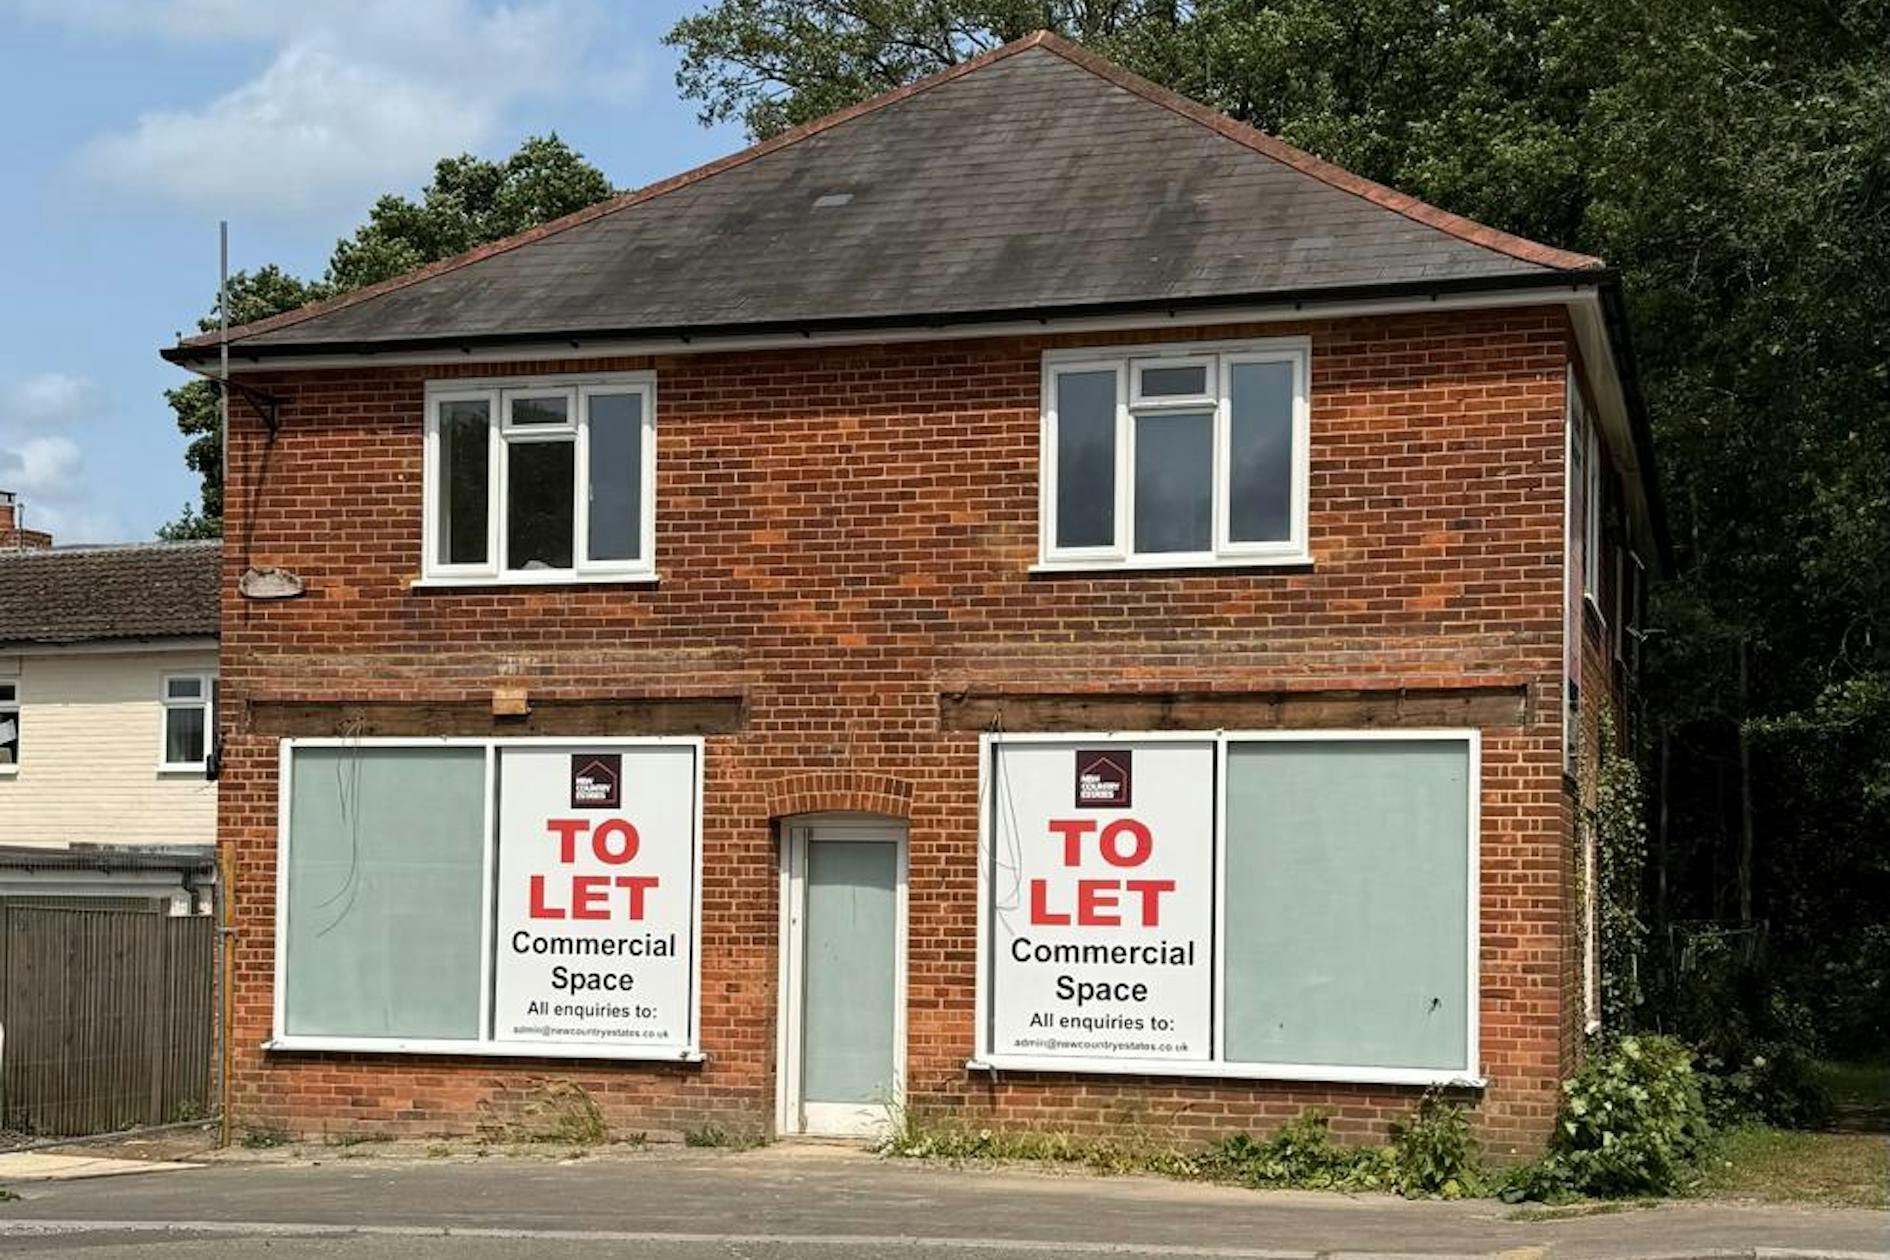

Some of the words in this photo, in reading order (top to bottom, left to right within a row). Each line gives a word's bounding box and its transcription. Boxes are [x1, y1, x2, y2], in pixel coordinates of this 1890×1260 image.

[548, 819, 639, 864] TO
[1049, 818, 1152, 868] TO
[529, 875, 659, 919] LET
[1030, 879, 1175, 926] LET
[512, 931, 675, 958] Commercial
[1012, 938, 1194, 966] Commercial
[552, 966, 634, 993] Space
[1056, 975, 1148, 1005] Space
[528, 1001, 549, 1016] All
[554, 1003, 629, 1019] enquiries
[636, 1005, 658, 1018] to:
[1030, 1013, 1053, 1028] All
[1060, 1014, 1143, 1033] enquiries
[1151, 1016, 1175, 1031] to:
[513, 1025, 668, 1039] admin@newcountryestates.co.uk
[1014, 1038, 1188, 1052] admin@newcountryestates.co.uk
